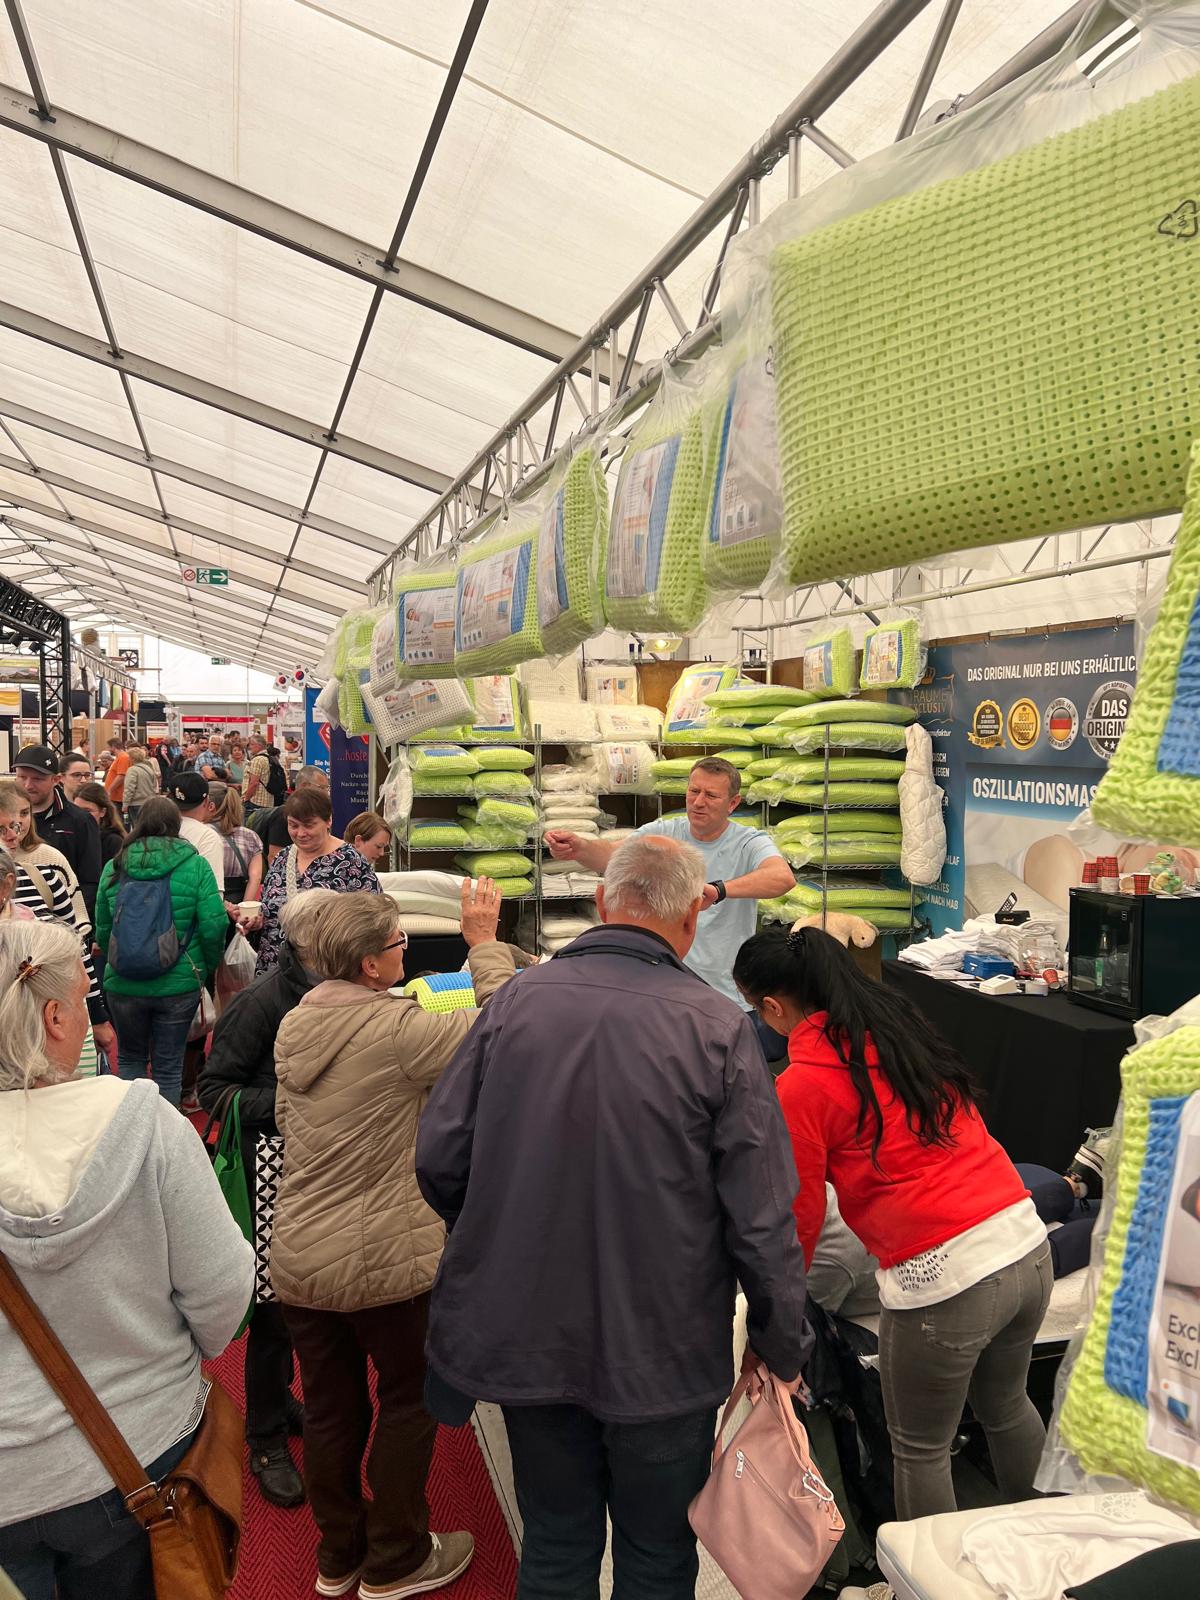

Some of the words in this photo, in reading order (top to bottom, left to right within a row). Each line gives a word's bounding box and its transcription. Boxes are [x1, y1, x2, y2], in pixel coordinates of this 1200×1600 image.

[967, 668, 983, 682] DAS
[984, 664, 1021, 681] ORIGINAL
[1023, 663, 1042, 678] NUR
[1043, 661, 1059, 677] BEI
[1060, 659, 1081, 676] UNS
[1101, 699, 1128, 717] DAS
[973, 777, 1098, 807] OSZILLATIONSMAS
[1168, 1314, 1200, 1343] Excl
[1165, 1340, 1200, 1370] Excl
